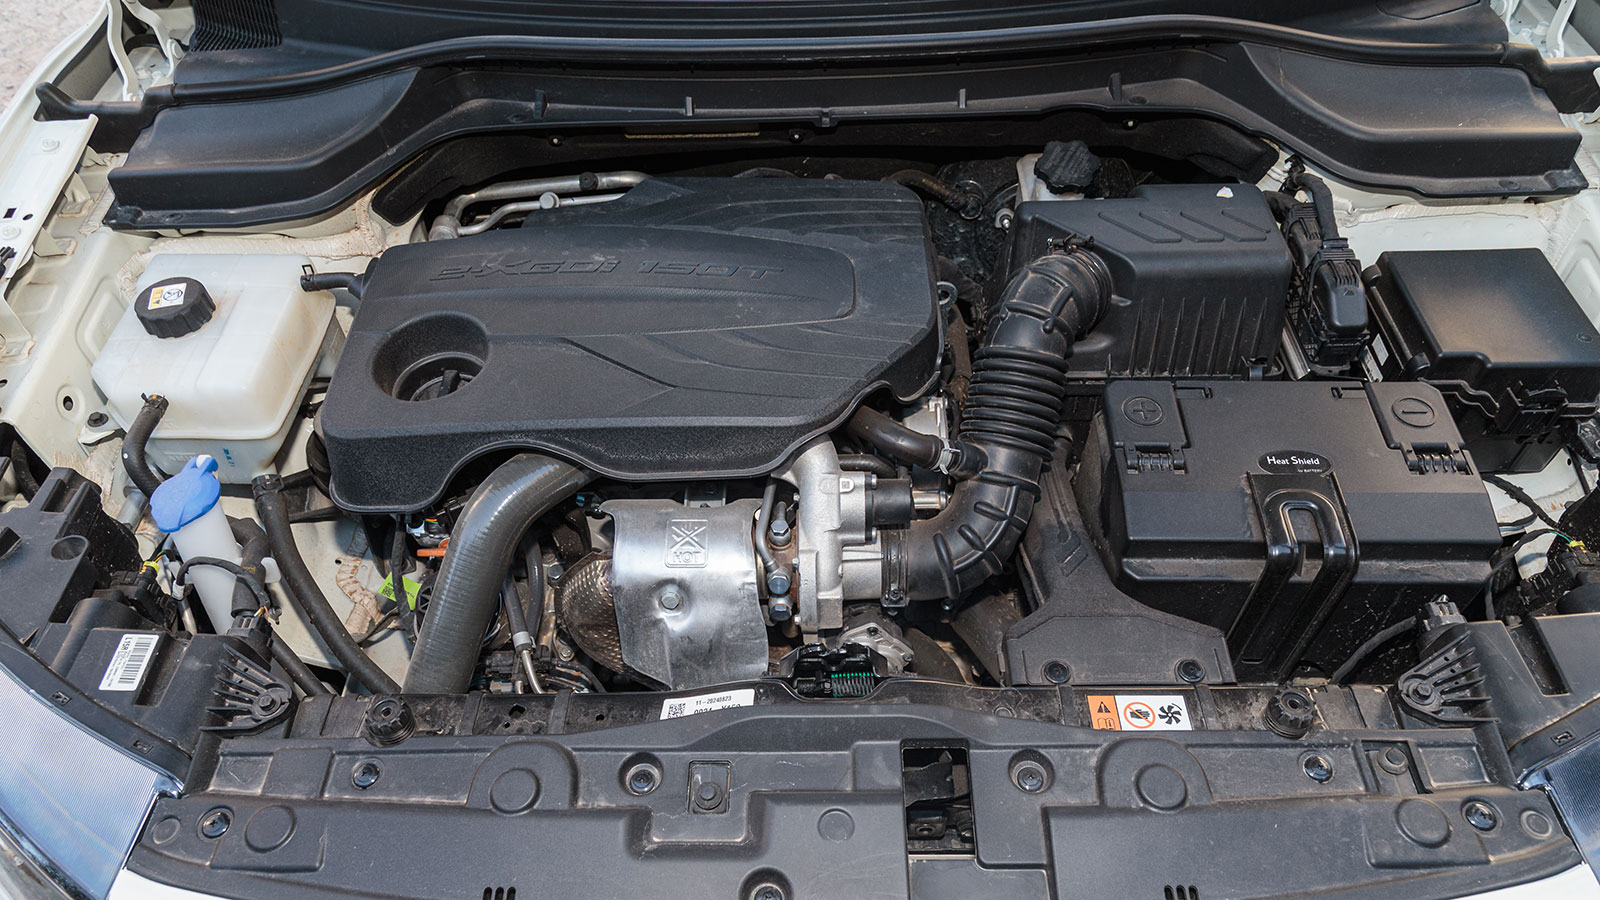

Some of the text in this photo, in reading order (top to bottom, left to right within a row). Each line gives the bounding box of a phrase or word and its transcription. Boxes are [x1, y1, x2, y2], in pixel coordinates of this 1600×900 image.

[638, 260, 785, 280] 150T
[1266, 455, 1320, 465] Heat Shield
[672, 551, 702, 563] HOT
